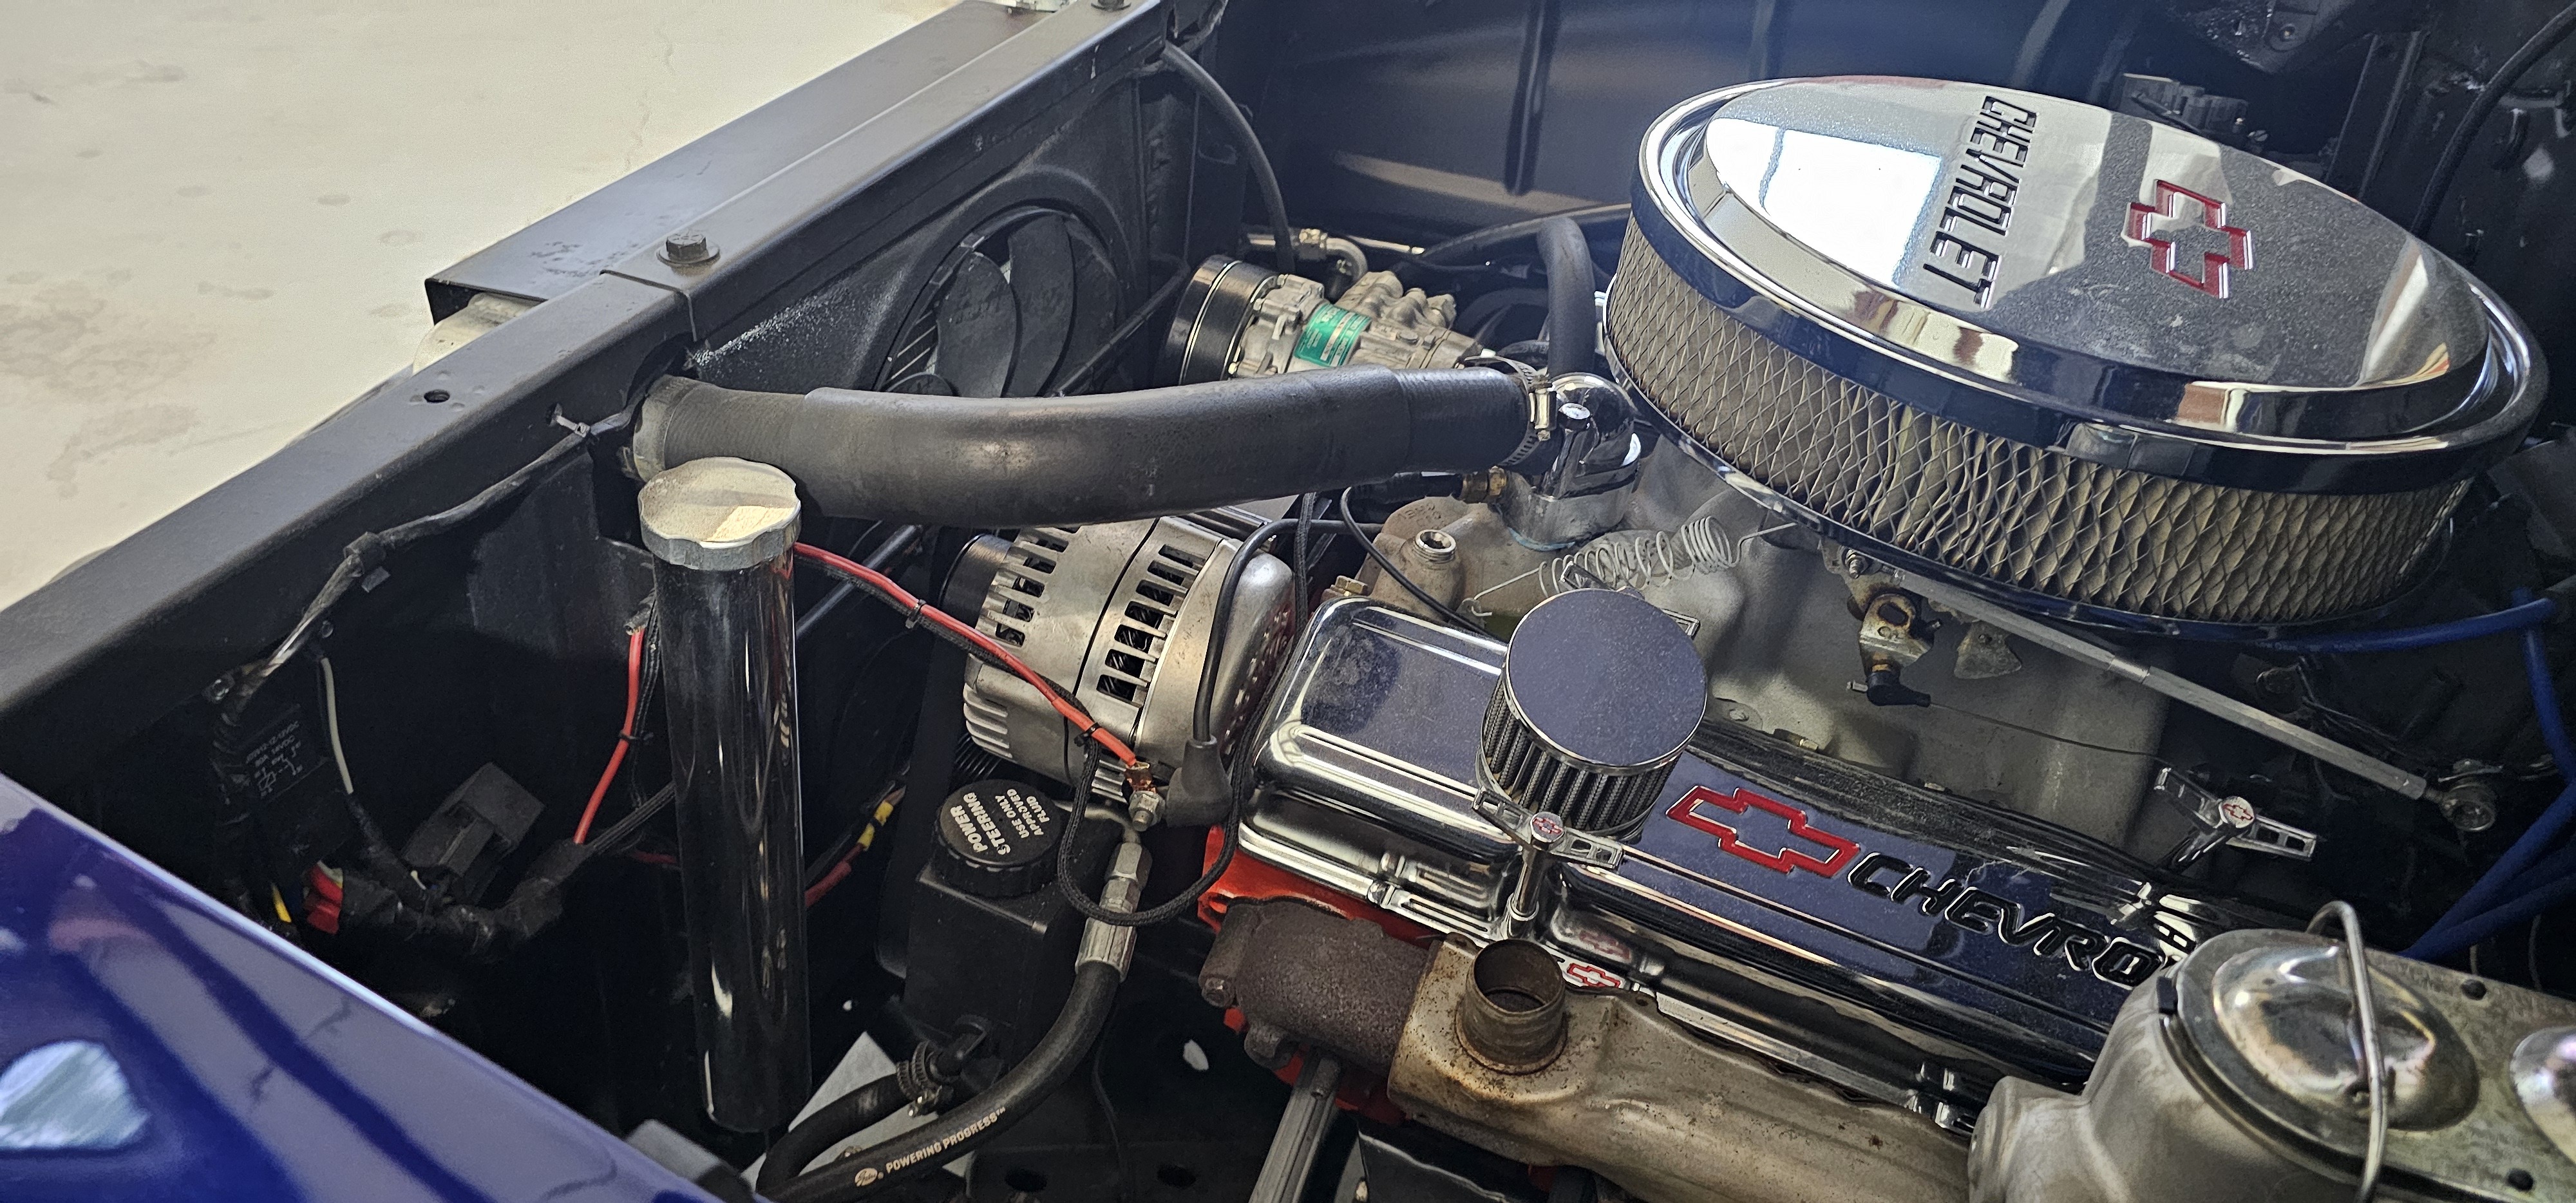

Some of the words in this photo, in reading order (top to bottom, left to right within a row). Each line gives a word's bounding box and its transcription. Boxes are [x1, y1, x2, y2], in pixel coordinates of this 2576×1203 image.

[1923, 95, 2040, 310] CHEVROLET
[950, 805, 989, 853] POWER
[963, 792, 1011, 855] STEERING
[994, 795, 1016, 819] ONLY
[1007, 788, 1045, 836] APPROVED
[1011, 818, 1030, 838] USE
[1026, 795, 1050, 823] FLUID
[1848, 851, 2174, 990] CHEVRO
[886, 1142, 942, 1174] POWERING
